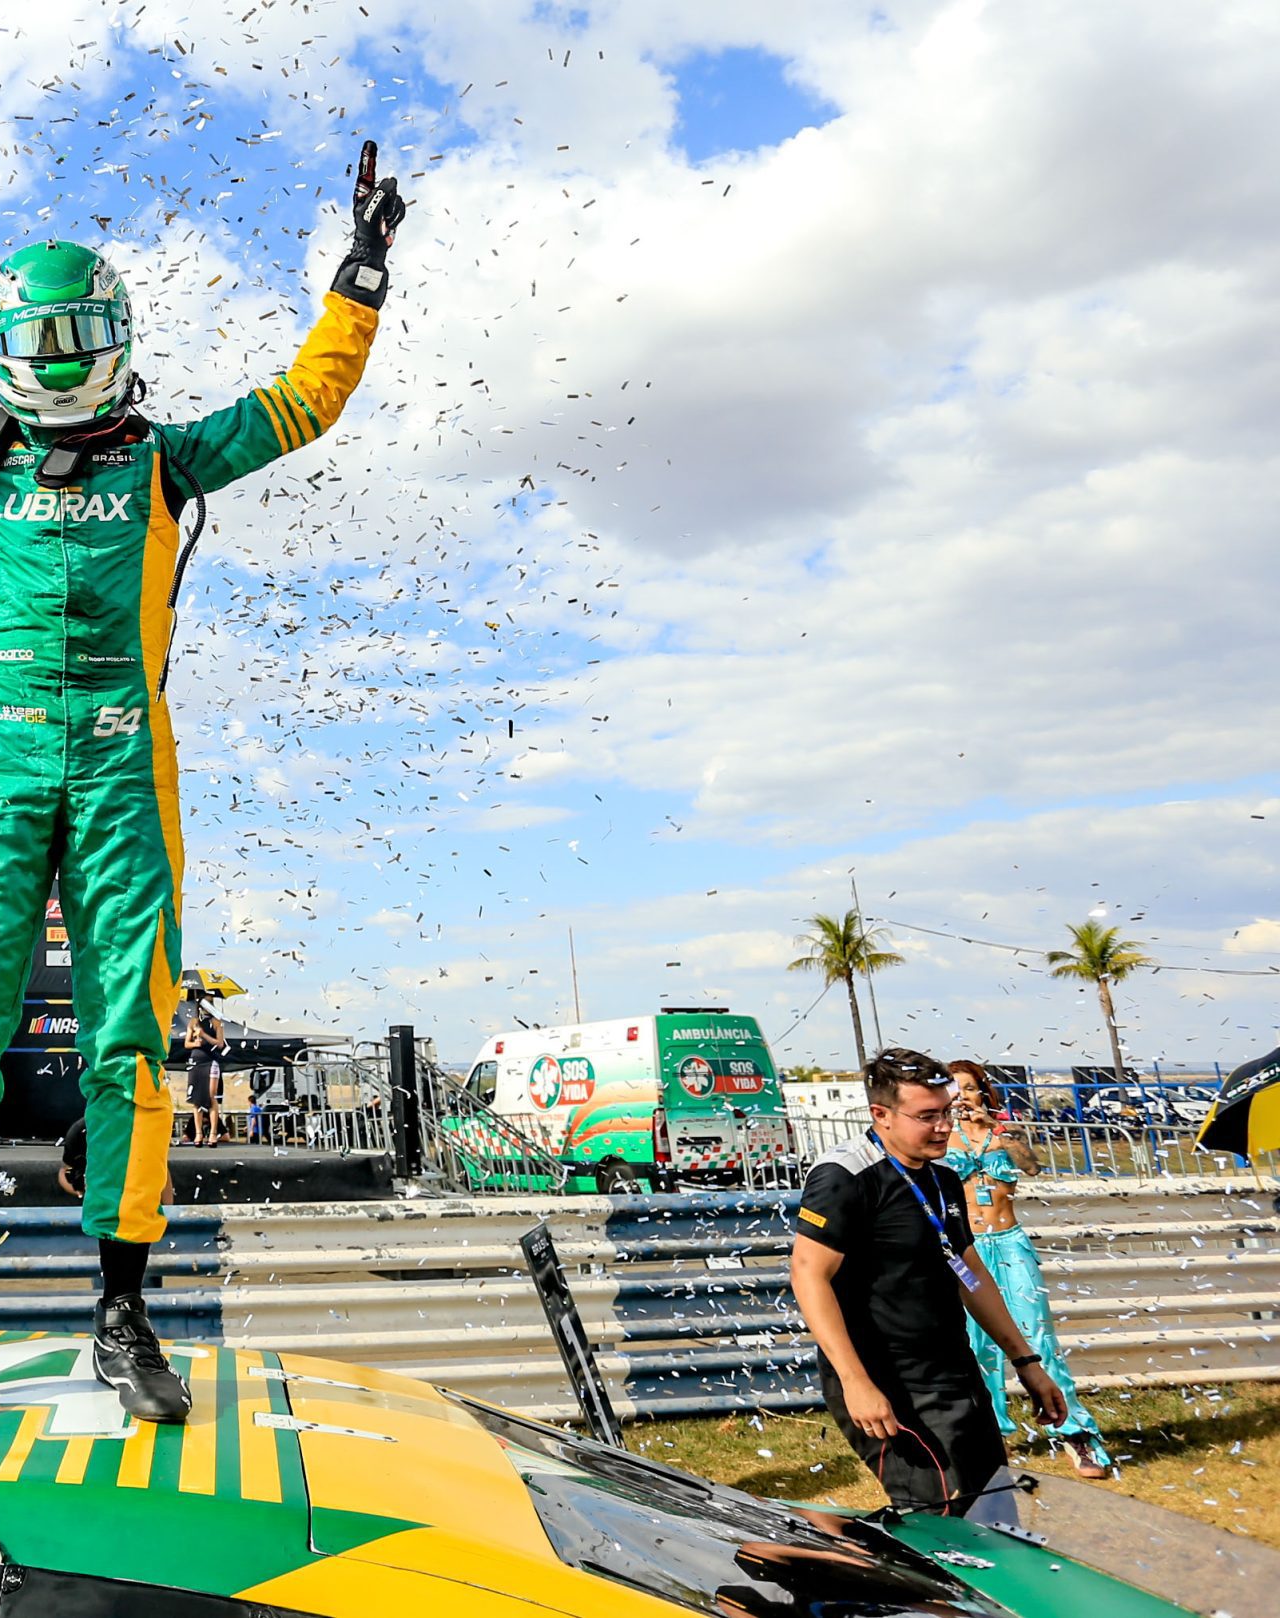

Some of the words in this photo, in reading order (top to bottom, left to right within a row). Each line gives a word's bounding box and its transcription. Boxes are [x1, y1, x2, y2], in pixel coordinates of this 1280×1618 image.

[12, 303, 105, 322] MOSCATO
[2, 705, 47, 716] #team
[93, 706, 144, 737] 54
[563, 1060, 588, 1081] SOS
[730, 1062, 755, 1075] SOS
[563, 1082, 588, 1101] VIDA
[732, 1077, 758, 1090] VIDA
